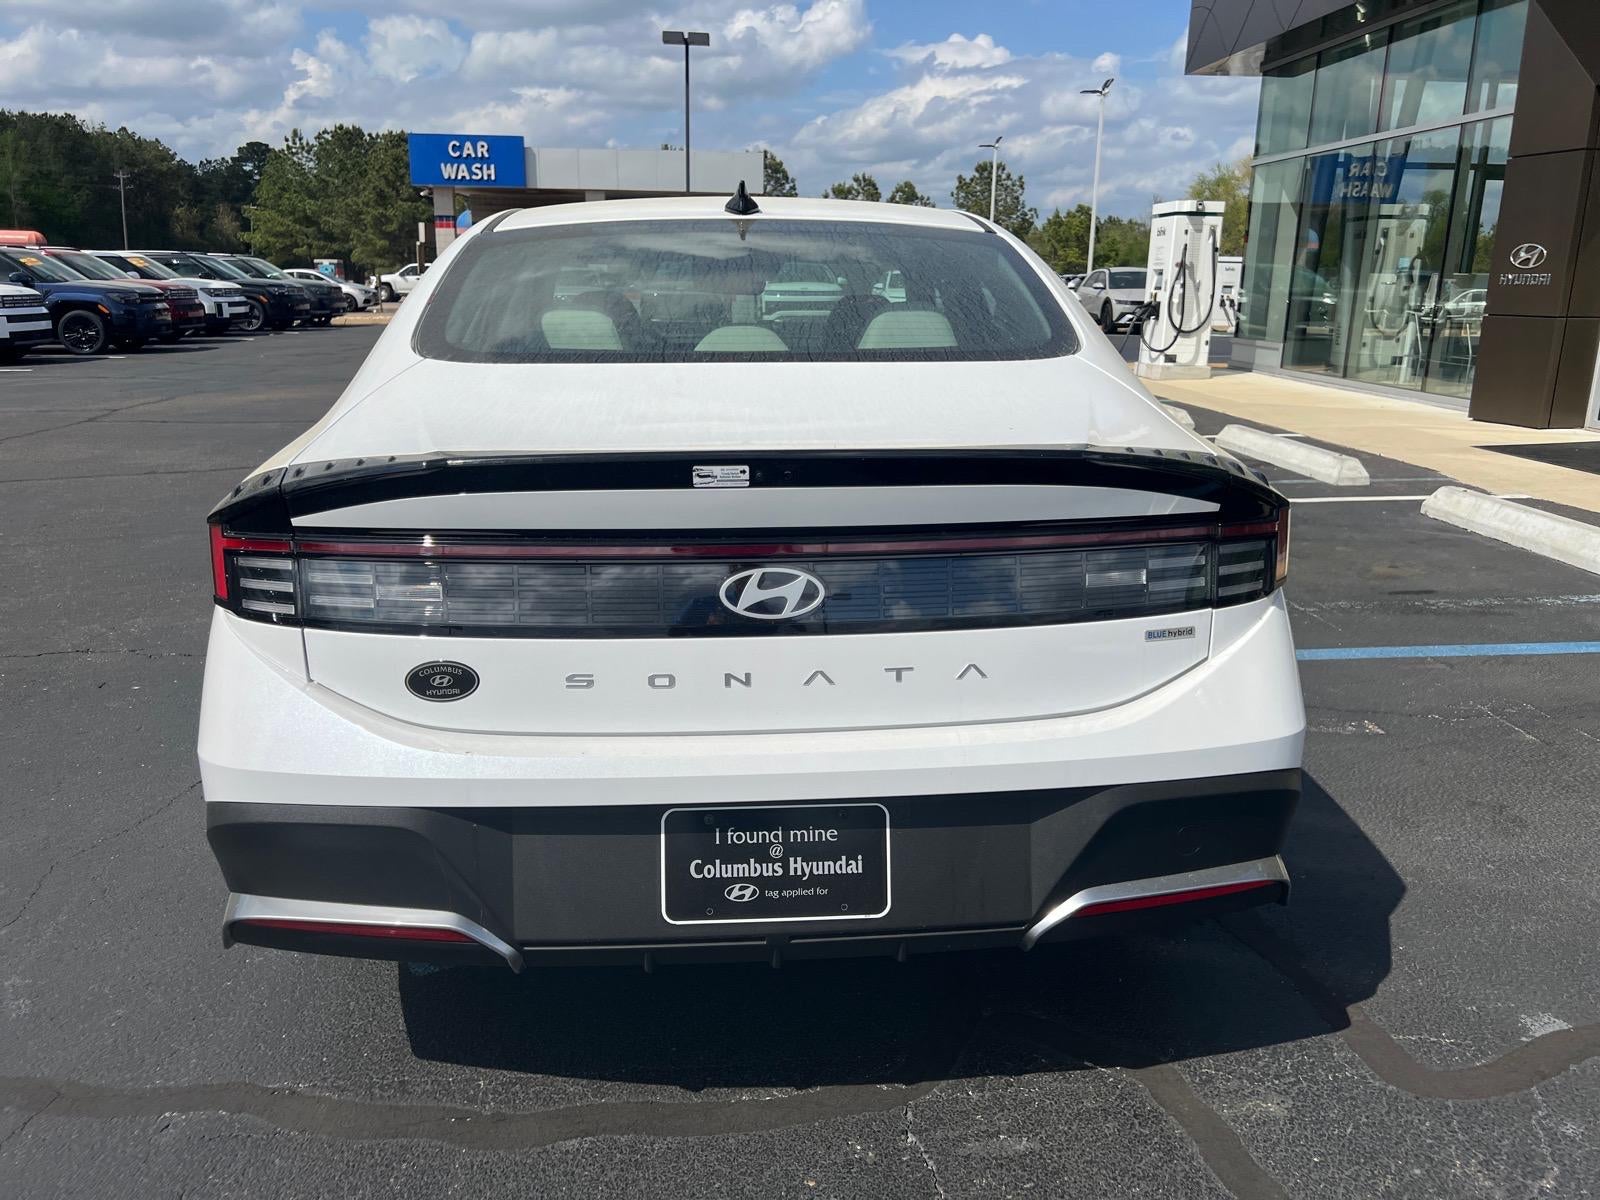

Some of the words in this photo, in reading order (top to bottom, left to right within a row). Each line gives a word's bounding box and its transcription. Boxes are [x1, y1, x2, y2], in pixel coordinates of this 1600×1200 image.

[448, 140, 489, 158] CAR
[440, 162, 496, 181] WASH
[1499, 273, 1552, 285] HYUNDAI
[418, 666, 463, 677] COLUMBUS
[565, 663, 988, 690] SONATA
[426, 688, 460, 696] HYUNDAI
[727, 827, 783, 844] found
[790, 826, 838, 842] mine
[769, 843, 784, 859] @
[689, 859, 784, 879] Columbus
[789, 854, 863, 881] Hyundai
[765, 889, 779, 898] tag
[781, 887, 814, 897] applied
[816, 886, 828, 895] for
